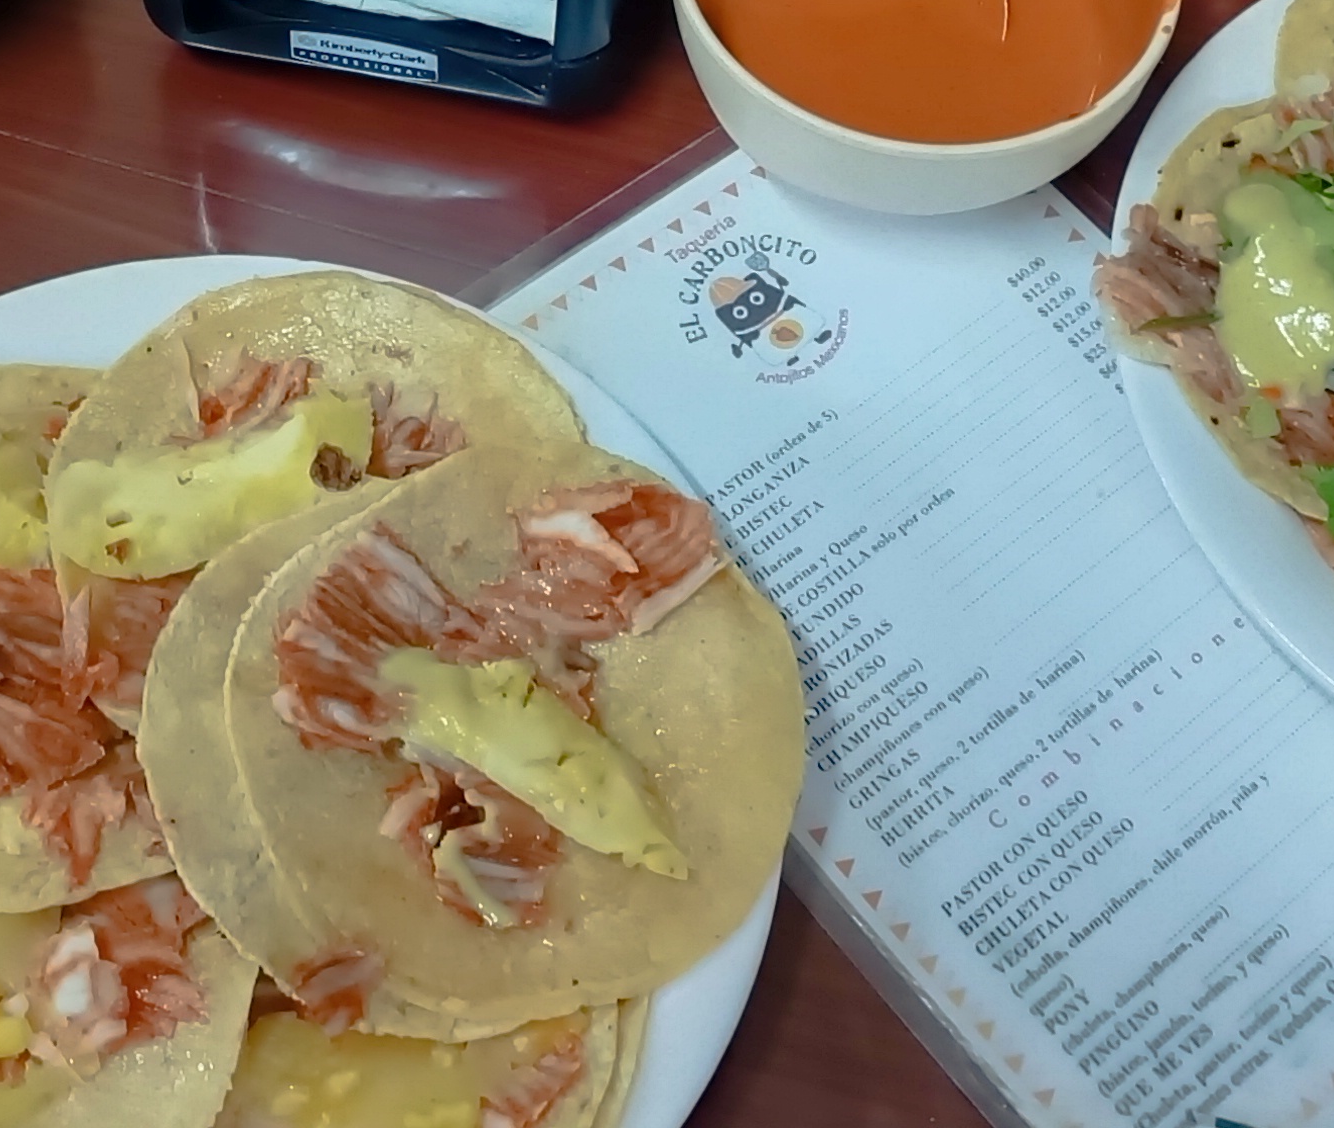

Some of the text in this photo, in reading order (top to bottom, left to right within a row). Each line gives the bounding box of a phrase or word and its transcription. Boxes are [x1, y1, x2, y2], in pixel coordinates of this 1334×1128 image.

[298, 50, 424, 78] PROFESSIONAL
[678, 233, 818, 344] EL CARBONCITO
[1021, 270, 1062, 304] $12.00
[1036, 285, 1077, 319] $12.00
[1051, 300, 1093, 334] $12.00
[755, 308, 850, 385] Antojitos Mexicanos
[702, 408, 840, 509] PASTOR (orden de 5)
[719, 455, 811, 524] LONGANIZA
[734, 494, 793, 541] BISTEC
[750, 500, 826, 557] CHULETA
[796, 549, 872, 608] COSTILLA
[870, 531, 898, 554] solo
[896, 513, 920, 538] por
[919, 487, 956, 517] orden
[818, 553, 830, 569] y
[827, 524, 869, 557] Queso
[789, 582, 865, 644] FUNDIDO
[794, 613, 862, 672] ADILLAS
[799, 619, 893, 698] RONIZADAS
[802, 654, 887, 730] ORIQUESO
[803, 657, 925, 759] (chorizo con queso)
[813, 680, 929, 779] CHAMPIQUESO
[829, 665, 990, 797] (champiñones con queso)
[1034, 738, 1050, 754] 2
[1046, 701, 1098, 744] tortillas
[1096, 688, 1115, 705] de
[1112, 647, 1164, 690] harina)
[864, 787, 920, 832] (pastor,
[955, 739, 971, 755] 2
[968, 703, 1020, 746] tortillas
[1018, 689, 1037, 706] de
[1034, 648, 1087, 691] harina)
[848, 748, 921, 810] GRINGAS
[879, 785, 956, 848] BURRITA
[940, 789, 1089, 919] PASTOR CON QUESO
[1151, 847, 1184, 876] chile
[1230, 780, 1260, 812] piña
[1258, 771, 1270, 788] y
[957, 810, 1104, 938] BISTEC CON QUESO
[974, 817, 1135, 957] CHULETA CON QUESO
